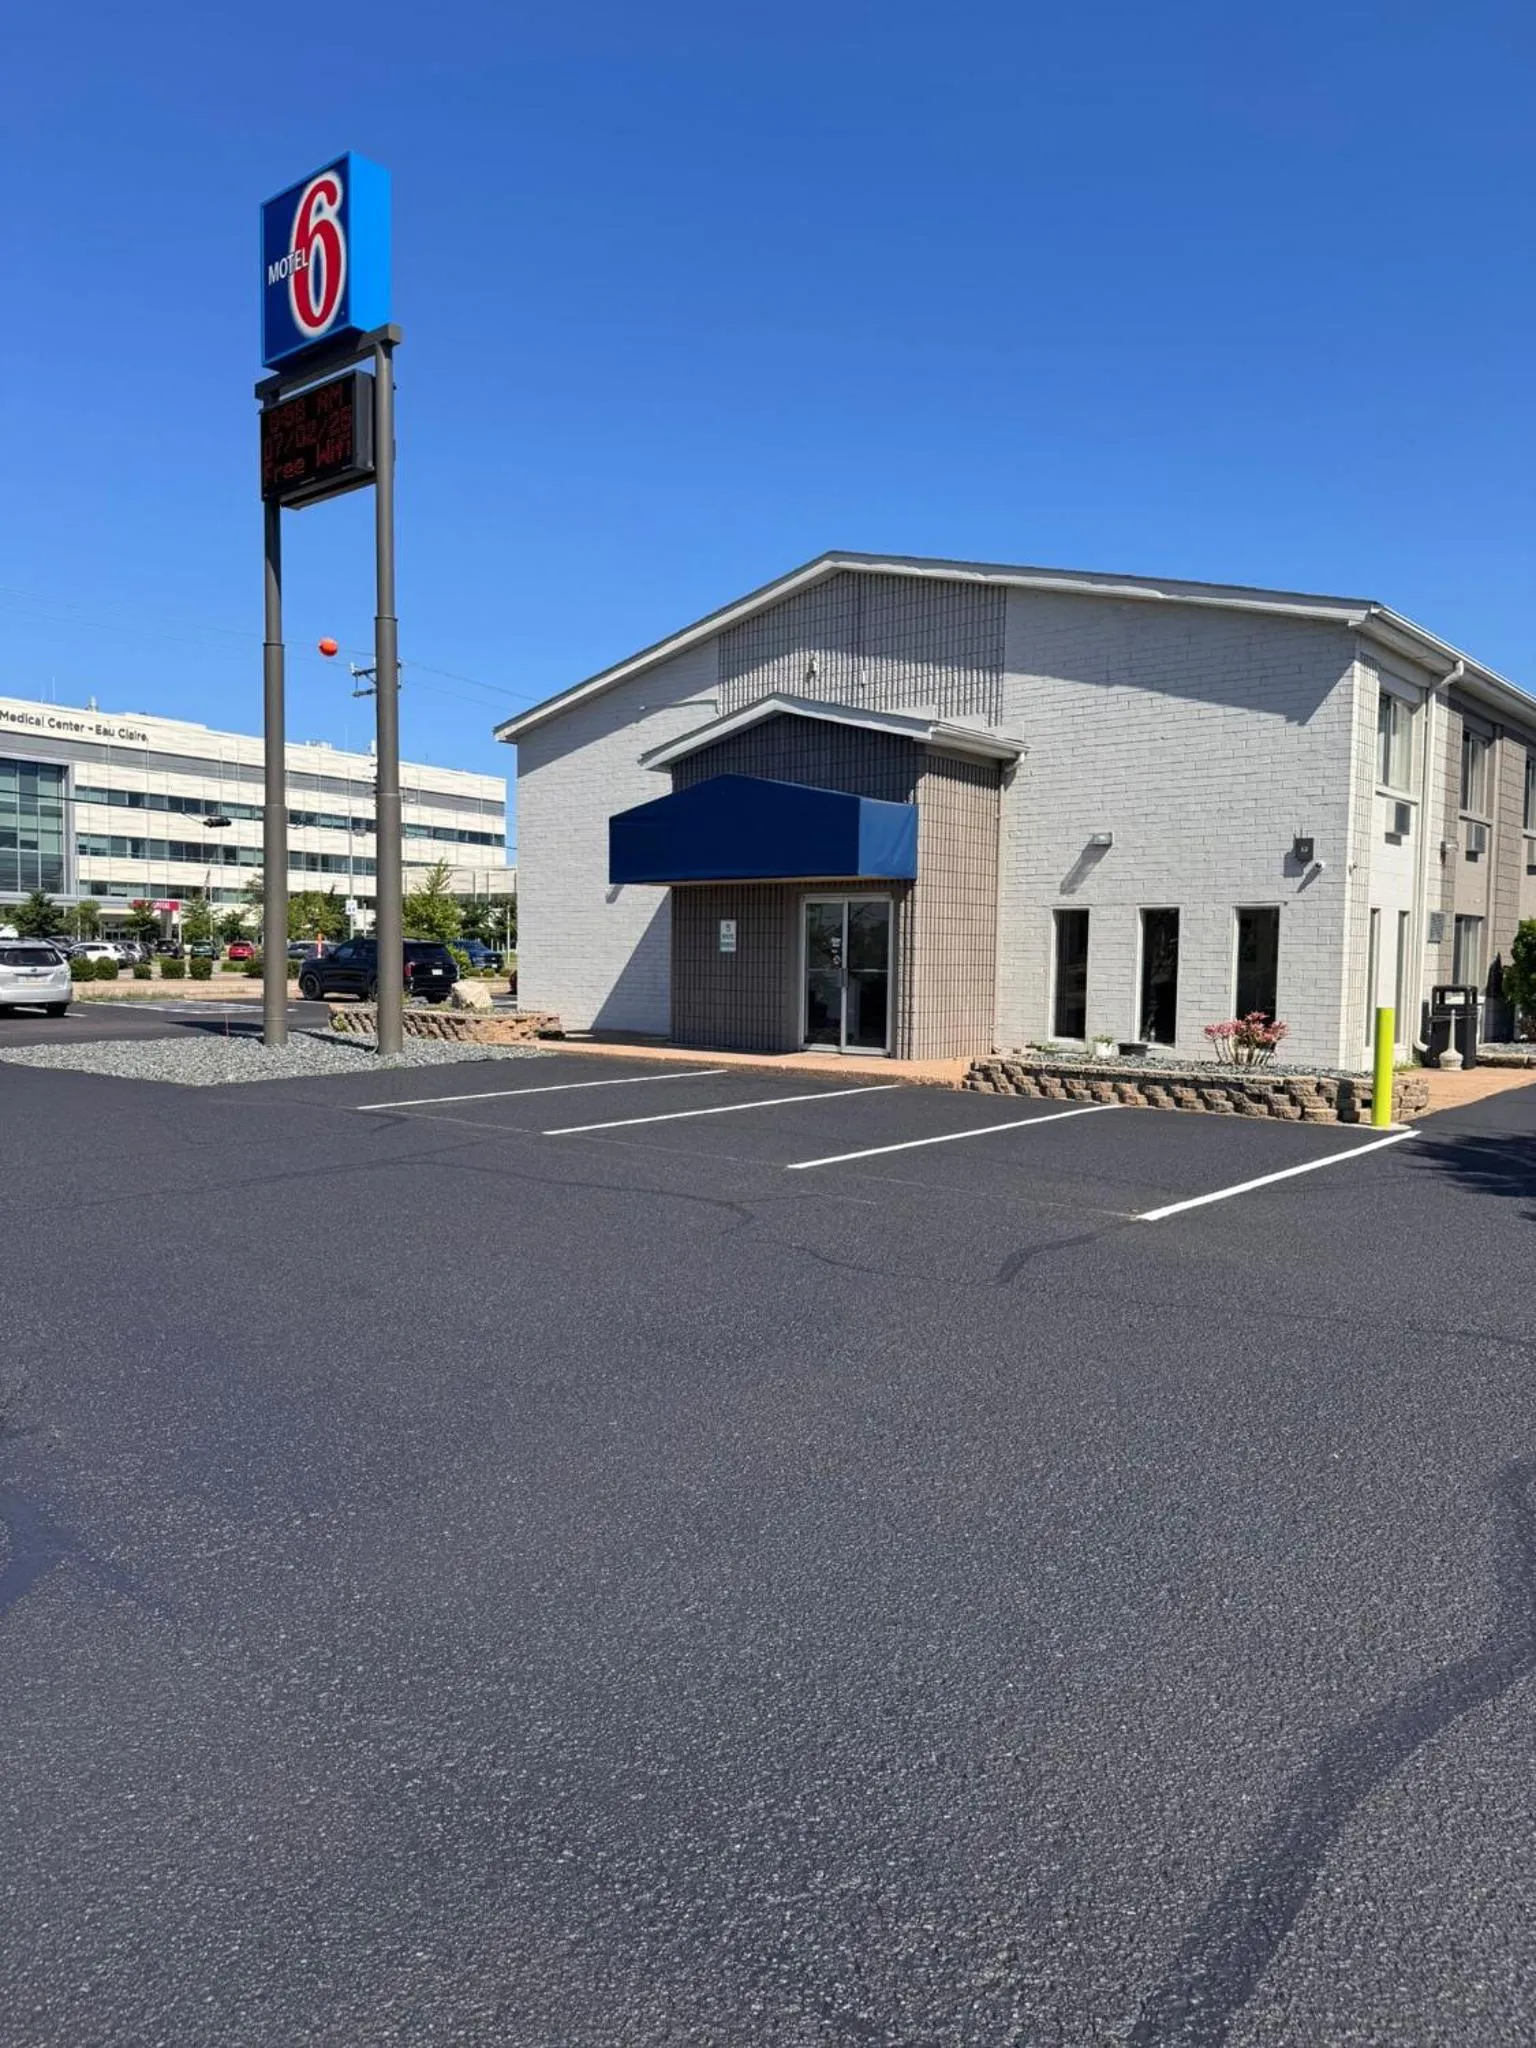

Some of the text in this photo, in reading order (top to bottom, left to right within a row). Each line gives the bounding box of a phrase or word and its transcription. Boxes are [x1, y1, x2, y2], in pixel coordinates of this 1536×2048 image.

[268, 171, 346, 338] MOTEL 6
[263, 457, 305, 486] Free
[0, 710, 44, 728] Medical
[48, 717, 85, 733] Center
[95, 724, 115, 737] Eau
[118, 728, 148, 742] Claire
